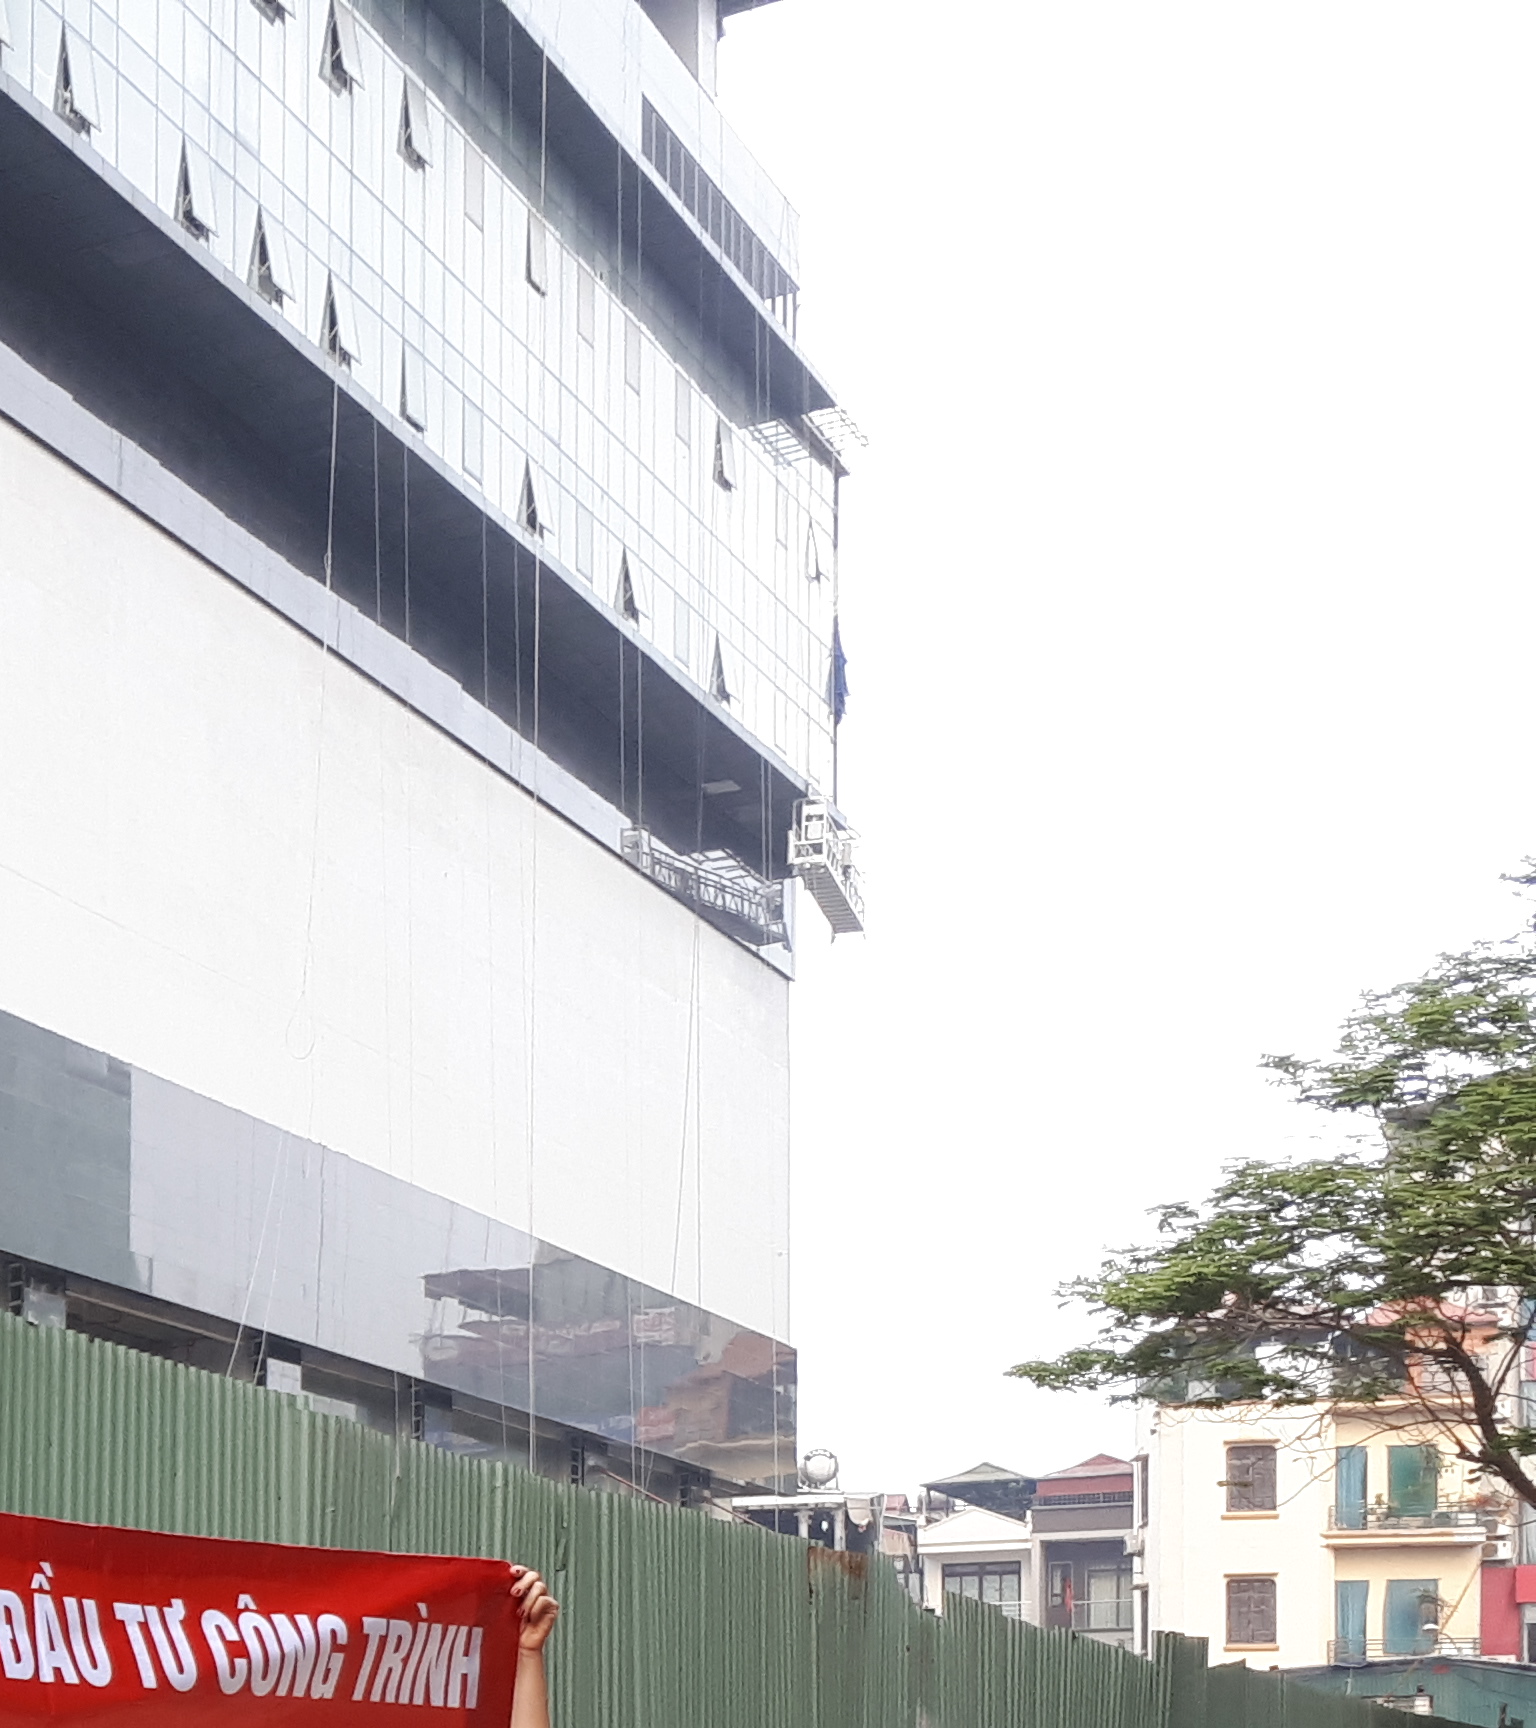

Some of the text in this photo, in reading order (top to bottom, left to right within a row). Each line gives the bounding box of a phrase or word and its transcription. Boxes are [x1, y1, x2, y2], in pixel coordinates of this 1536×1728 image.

[113, 1596, 198, 1692] TƯ
[201, 1593, 348, 1700] CÔNG
[351, 1601, 484, 1710] TRÌNH
